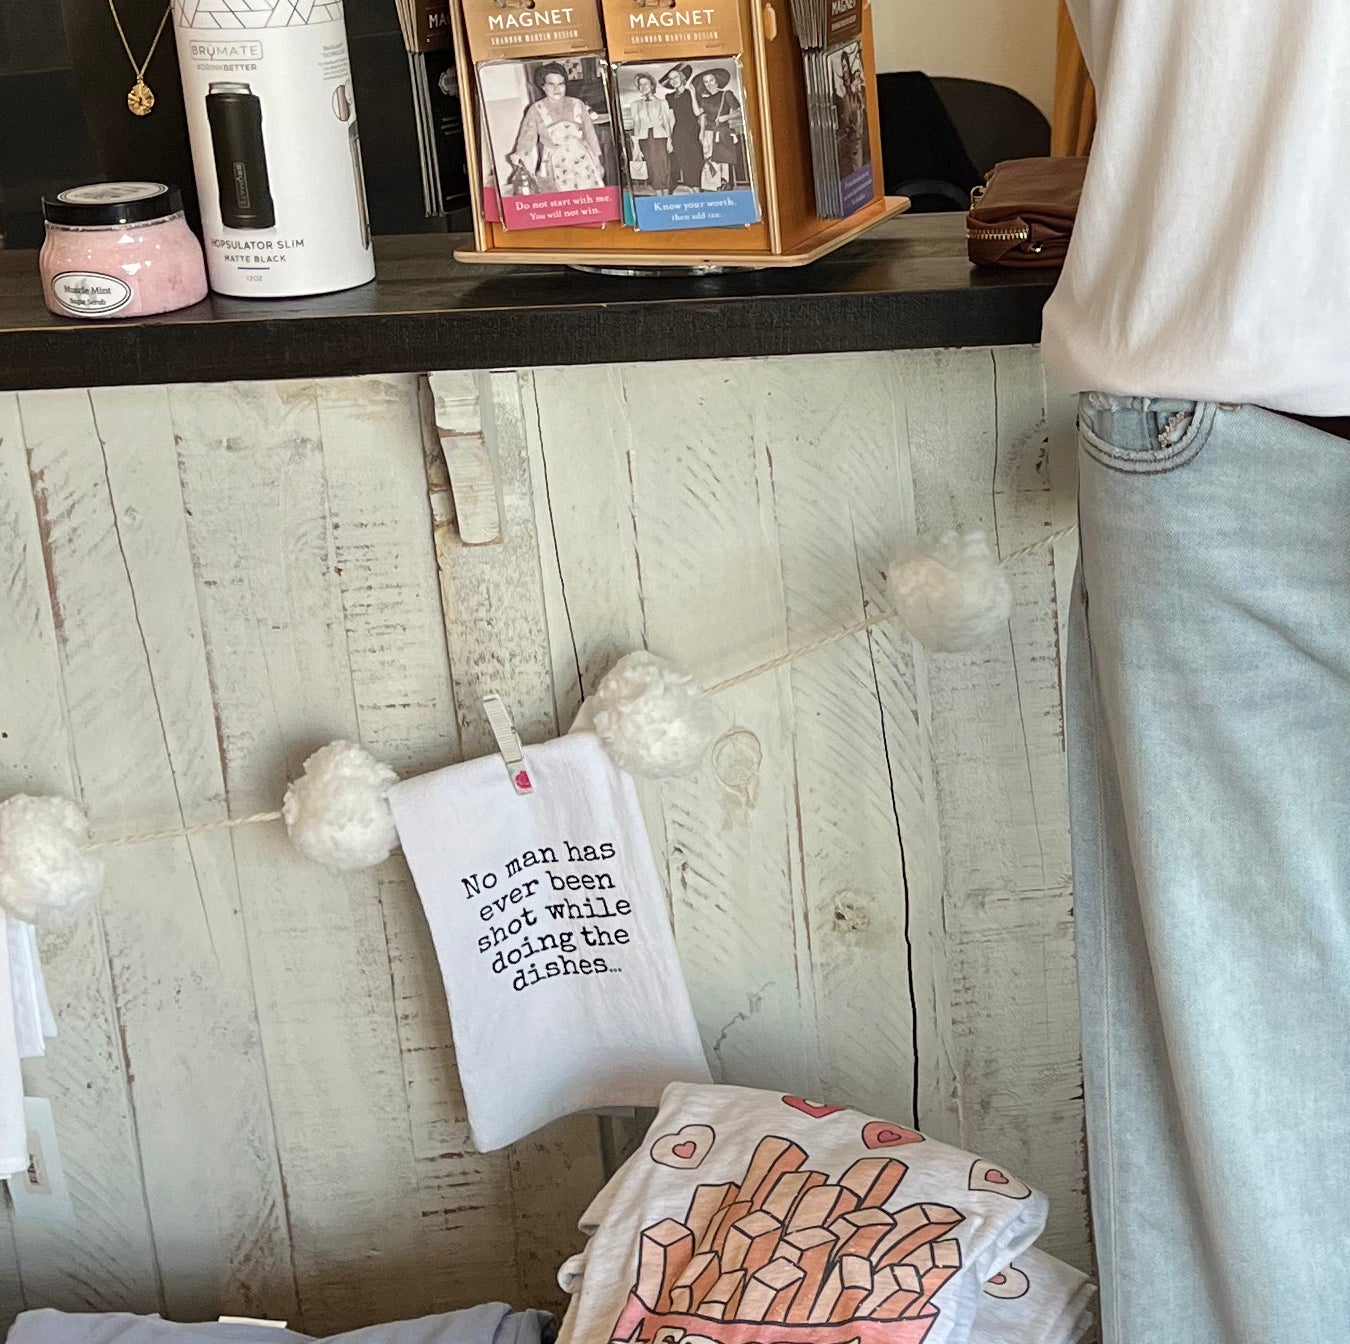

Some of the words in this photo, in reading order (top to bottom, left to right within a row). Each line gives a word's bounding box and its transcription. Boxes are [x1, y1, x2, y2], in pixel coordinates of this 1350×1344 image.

[488, 8, 574, 30] MAGNET
[629, 9, 715, 29] MAGNET
[515, 201, 531, 211] Do
[532, 200, 548, 209] not
[550, 198, 572, 208] start
[573, 196, 594, 206] with
[595, 196, 612, 204] me.
[653, 202, 682, 212] Know
[683, 201, 705, 212] your
[530, 211, 546, 221] You
[547, 209, 562, 219] will
[564, 208, 580, 217] not
[581, 207, 601, 216] win.
[211, 239, 273, 250] HOPSULATOR
[277, 239, 305, 249] SLIM
[224, 255, 251, 263] MATTE
[254, 254, 287, 263] BLACK
[461, 872, 498, 899] No
[505, 846, 559, 879] man
[563, 841, 616, 863] has
[479, 878, 540, 922] ever
[545, 871, 616, 891] been
[478, 907, 538, 953] shot
[545, 897, 632, 920] while
[491, 932, 574, 974] doing
[580, 926, 630, 947] the
